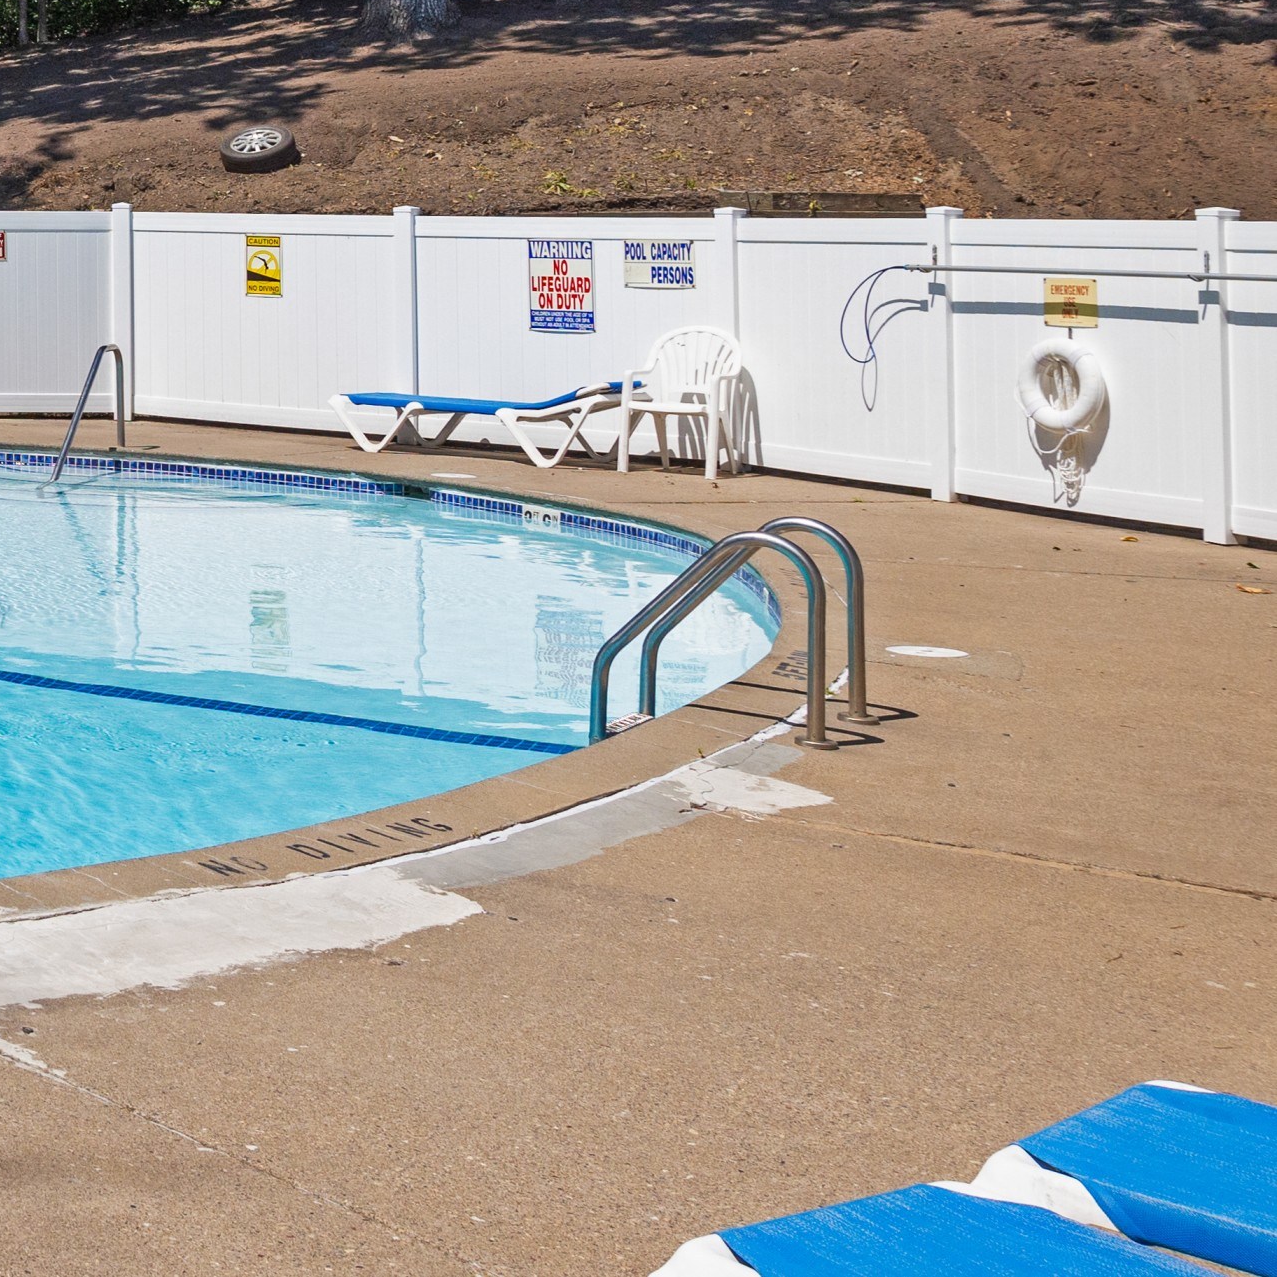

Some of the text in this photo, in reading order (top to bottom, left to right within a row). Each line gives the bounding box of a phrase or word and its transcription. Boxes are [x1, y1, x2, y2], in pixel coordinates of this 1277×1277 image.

[530, 241, 592, 259] WARNING
[625, 242, 692, 261] POOL CAPACITY
[553, 259, 568, 276] NO
[651, 266, 694, 285] PERSONS
[531, 275, 591, 294] LIFEGUARD
[1050, 284, 1089, 296] EMERGENCY
[538, 292, 585, 310] ON DUTY
[1062, 308, 1079, 319] ONLY
[286, 817, 453, 860] DIVING
